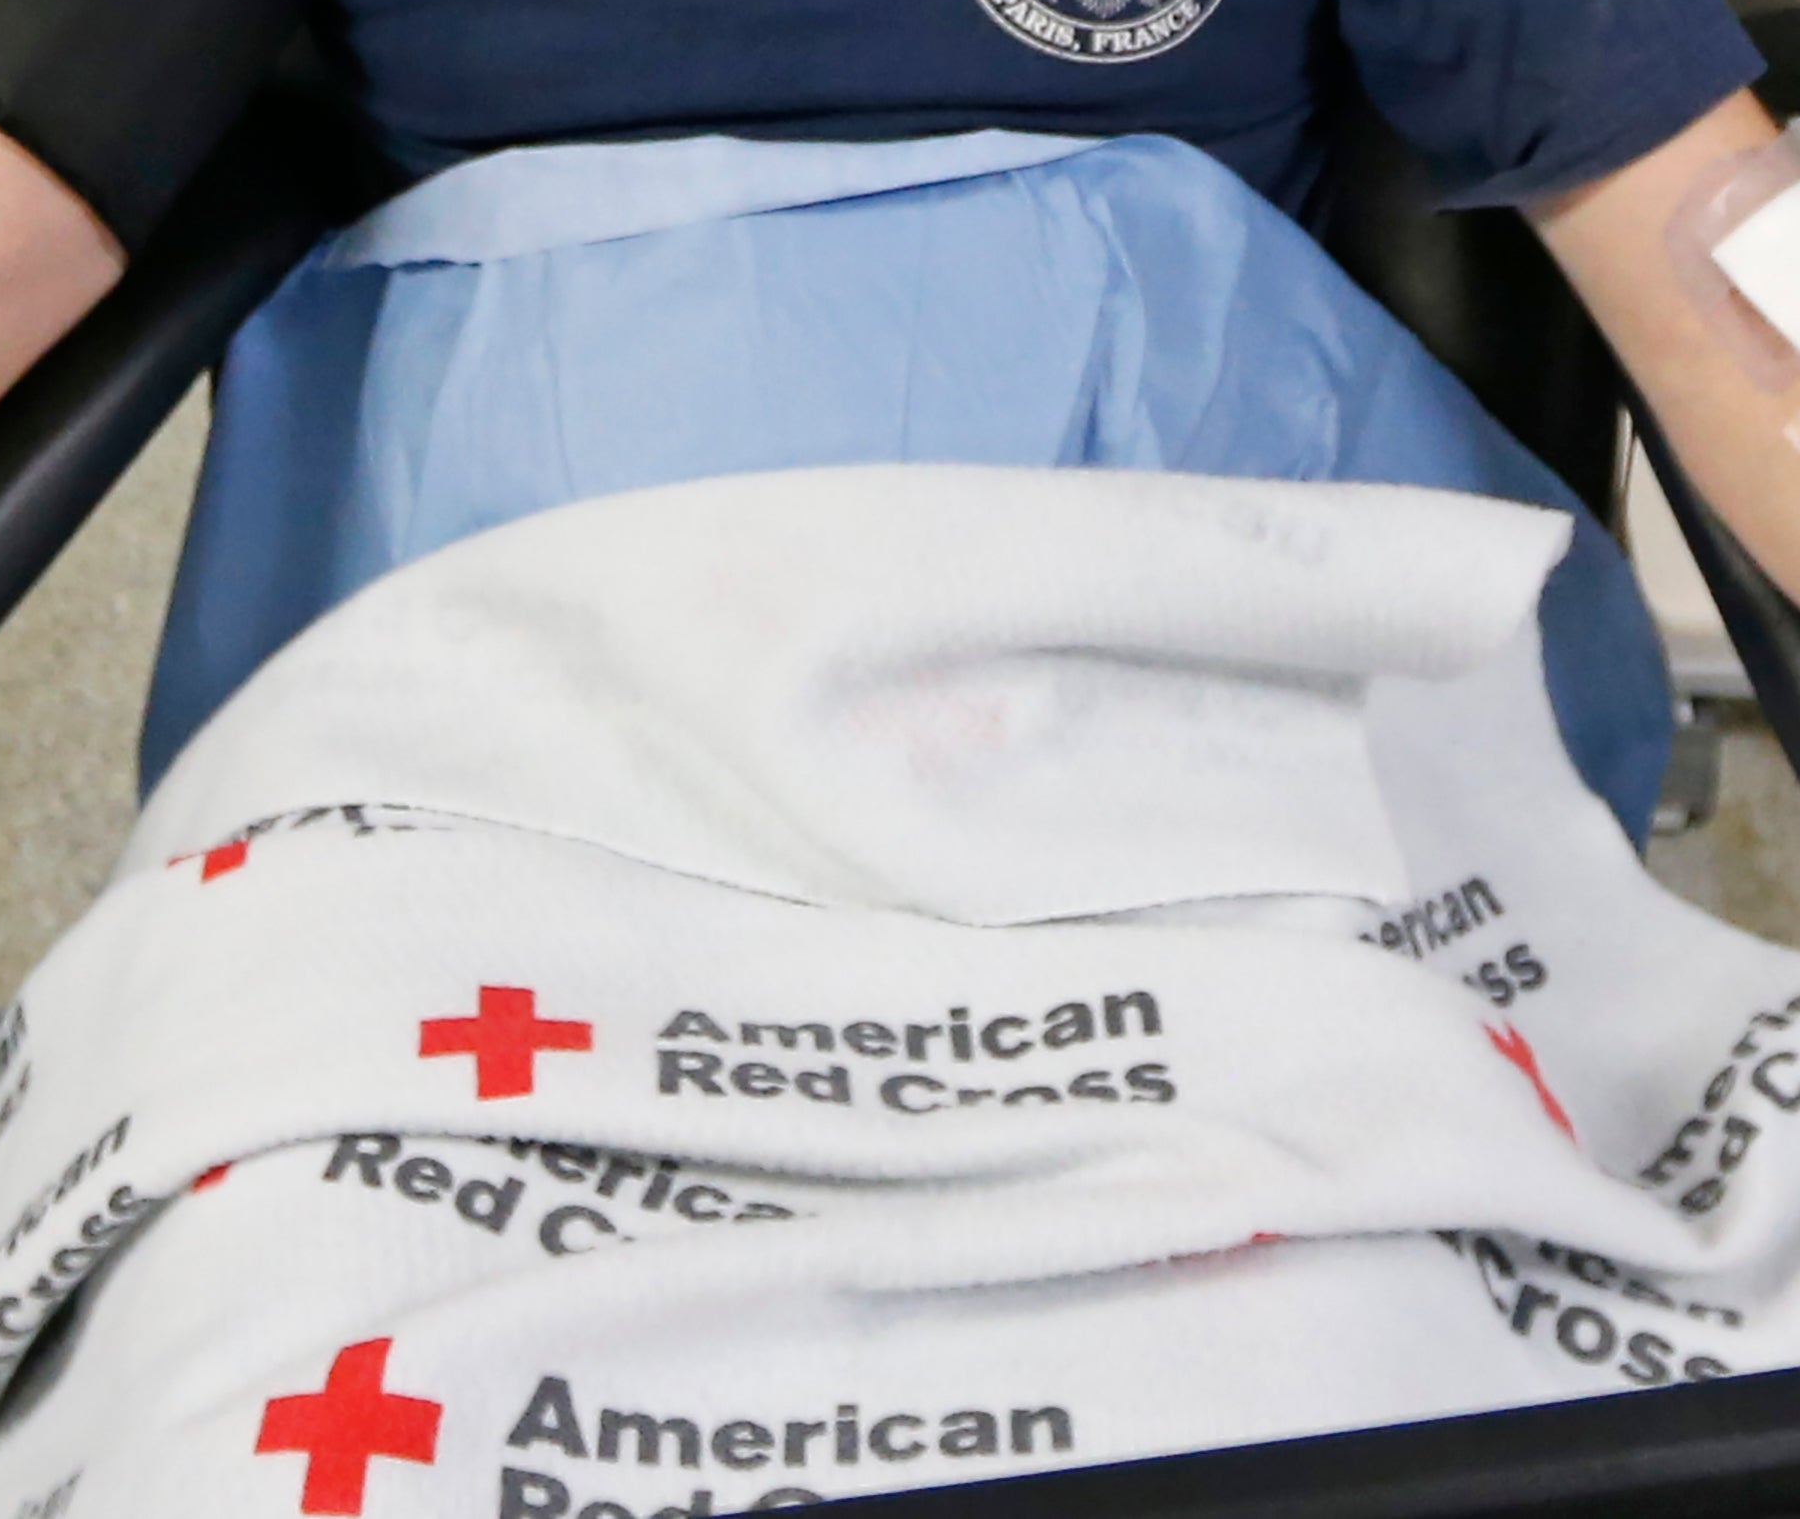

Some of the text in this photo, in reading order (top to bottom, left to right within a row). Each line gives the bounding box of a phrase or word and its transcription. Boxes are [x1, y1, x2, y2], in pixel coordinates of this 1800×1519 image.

[656, 989, 1163, 1062] American
[657, 1049, 852, 1107] Red
[323, 1133, 526, 1236] Red
[1679, 1115, 1761, 1216] ed
[506, 1375, 1075, 1470] American
